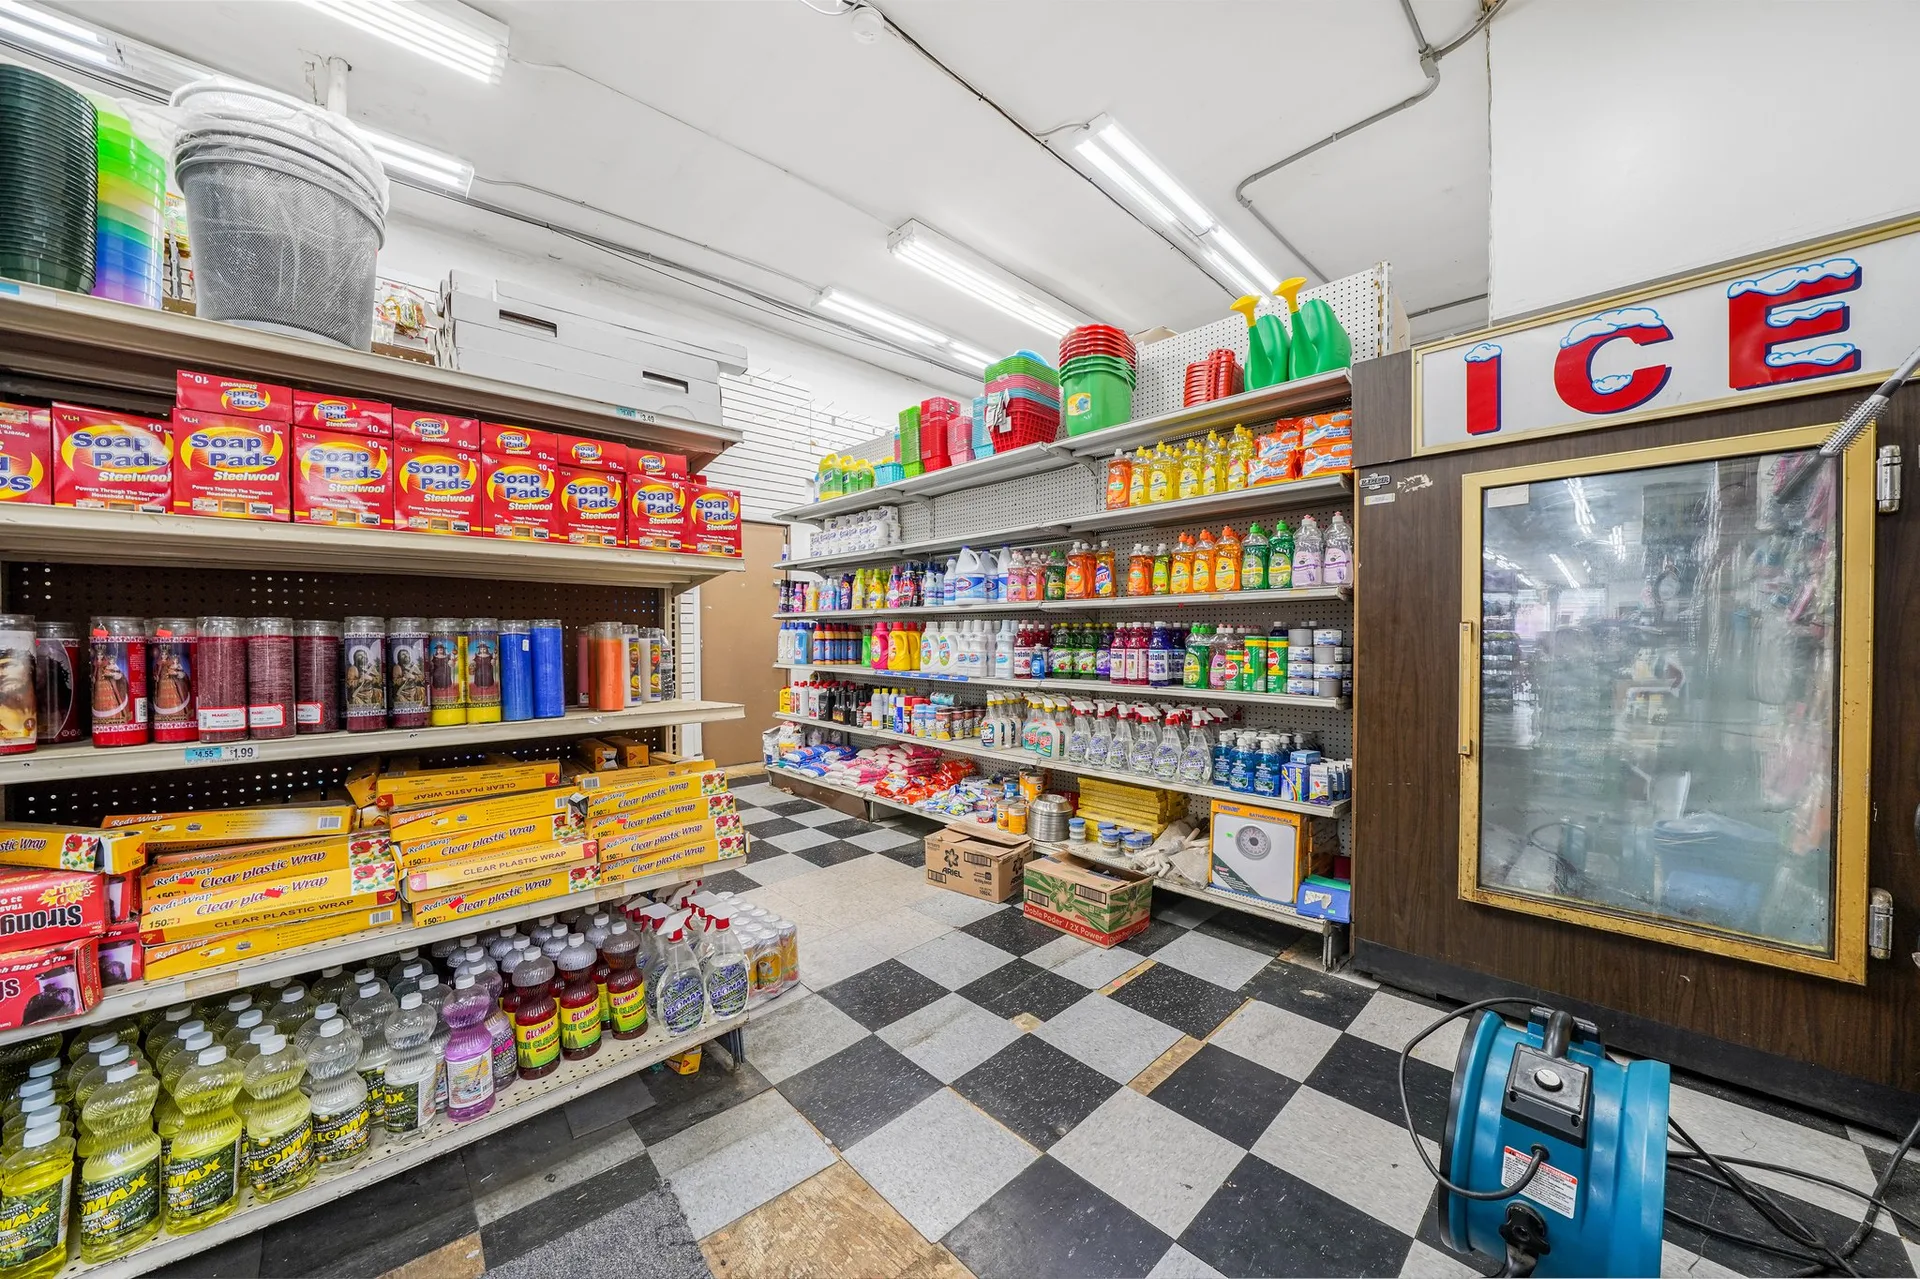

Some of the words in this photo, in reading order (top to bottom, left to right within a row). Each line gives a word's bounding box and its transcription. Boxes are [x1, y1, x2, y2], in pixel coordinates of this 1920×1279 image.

[1465, 257, 1862, 435] ICE
[195, 375, 209, 384] 10
[220, 382, 257, 390] Steelwool
[225, 390, 258, 399] Pads
[232, 398, 266, 408] Soap
[317, 403, 348, 412] Soap
[62, 414, 80, 422] YLH
[182, 416, 198, 424] YLH
[148, 423, 162, 432] 10
[258, 424, 272, 433] 10
[367, 424, 379, 432] 10
[414, 420, 441, 428] Soap
[421, 428, 446, 436] Pads
[72, 432, 151, 451] Soap
[190, 433, 262, 452] Soap
[500, 434, 524, 442] Soap
[366, 440, 378, 448] 10
[93, 452, 168, 467] Pads
[208, 452, 277, 466] Pads
[308, 448, 370, 465] Soap
[538, 452, 547, 460] 10
[325, 466, 383, 479] Pads
[406, 462, 461, 476] Soap
[98, 472, 172, 482] Steelwool
[212, 472, 280, 482] Steelwool
[493, 472, 541, 486] Soap
[192, 484, 214, 492] Powers
[328, 484, 386, 493] Steelwool
[420, 478, 471, 490] Pads
[100, 487, 126, 495] Through
[506, 487, 551, 498] Pads
[566, 484, 609, 496] Soap
[91, 492, 124, 500] Household
[424, 494, 474, 503] Steelwool
[637, 490, 674, 502] Soap
[508, 502, 553, 510] Steelwool
[578, 498, 618, 509] Pads
[647, 503, 682, 514] Pads
[696, 500, 729, 510] Soap
[580, 512, 620, 520] Steelwool
[704, 511, 736, 520] Pads
[230, 747, 254, 758] $1.99
[448, 785, 490, 796] PLASTIC
[490, 782, 516, 792] CLEAR
[412, 790, 446, 801] WRAP
[618, 796, 641, 808] Clear
[642, 788, 668, 802] plastic
[668, 781, 689, 792] Wrap
[622, 818, 646, 830] Clear
[646, 810, 673, 825] plastic
[674, 803, 696, 814] Wrap
[1249, 812, 1276, 821] BATHROOM
[441, 840, 470, 856] Clear
[472, 832, 506, 848] plastic
[508, 824, 536, 836] Wrap
[630, 840, 654, 852] Clear
[654, 830, 680, 846] plastic
[682, 824, 702, 835] Wrap
[19, 838, 48, 850] Wrap
[464, 864, 497, 876] CLEAR
[500, 857, 538, 870] PLASTIC
[540, 850, 567, 861] WRAP
[632, 862, 654, 874] Clear
[656, 853, 682, 868] plastic
[684, 845, 706, 857] Wrap
[200, 872, 240, 888] Clear
[242, 860, 290, 881] plastic
[291, 850, 328, 866] Wrap
[942, 867, 964, 878] ARIEL
[196, 894, 240, 916] Clear
[292, 875, 328, 892] Wrap
[456, 900, 487, 914] Clear
[488, 887, 524, 906] plastic
[524, 877, 553, 890] Wrap
[214, 915, 260, 928] CLEAR
[264, 906, 315, 920] PLASTIC
[318, 900, 354, 910] WRAP
[0, 905, 82, 936] Strong
[1024, 904, 1042, 918] Doble
[1070, 922, 1079, 932] 2X
[1080, 928, 1104, 942] Power
[108, 930, 122, 938] Tie
[11, 962, 39, 972] Bags
[52, 955, 67, 964] Tie
